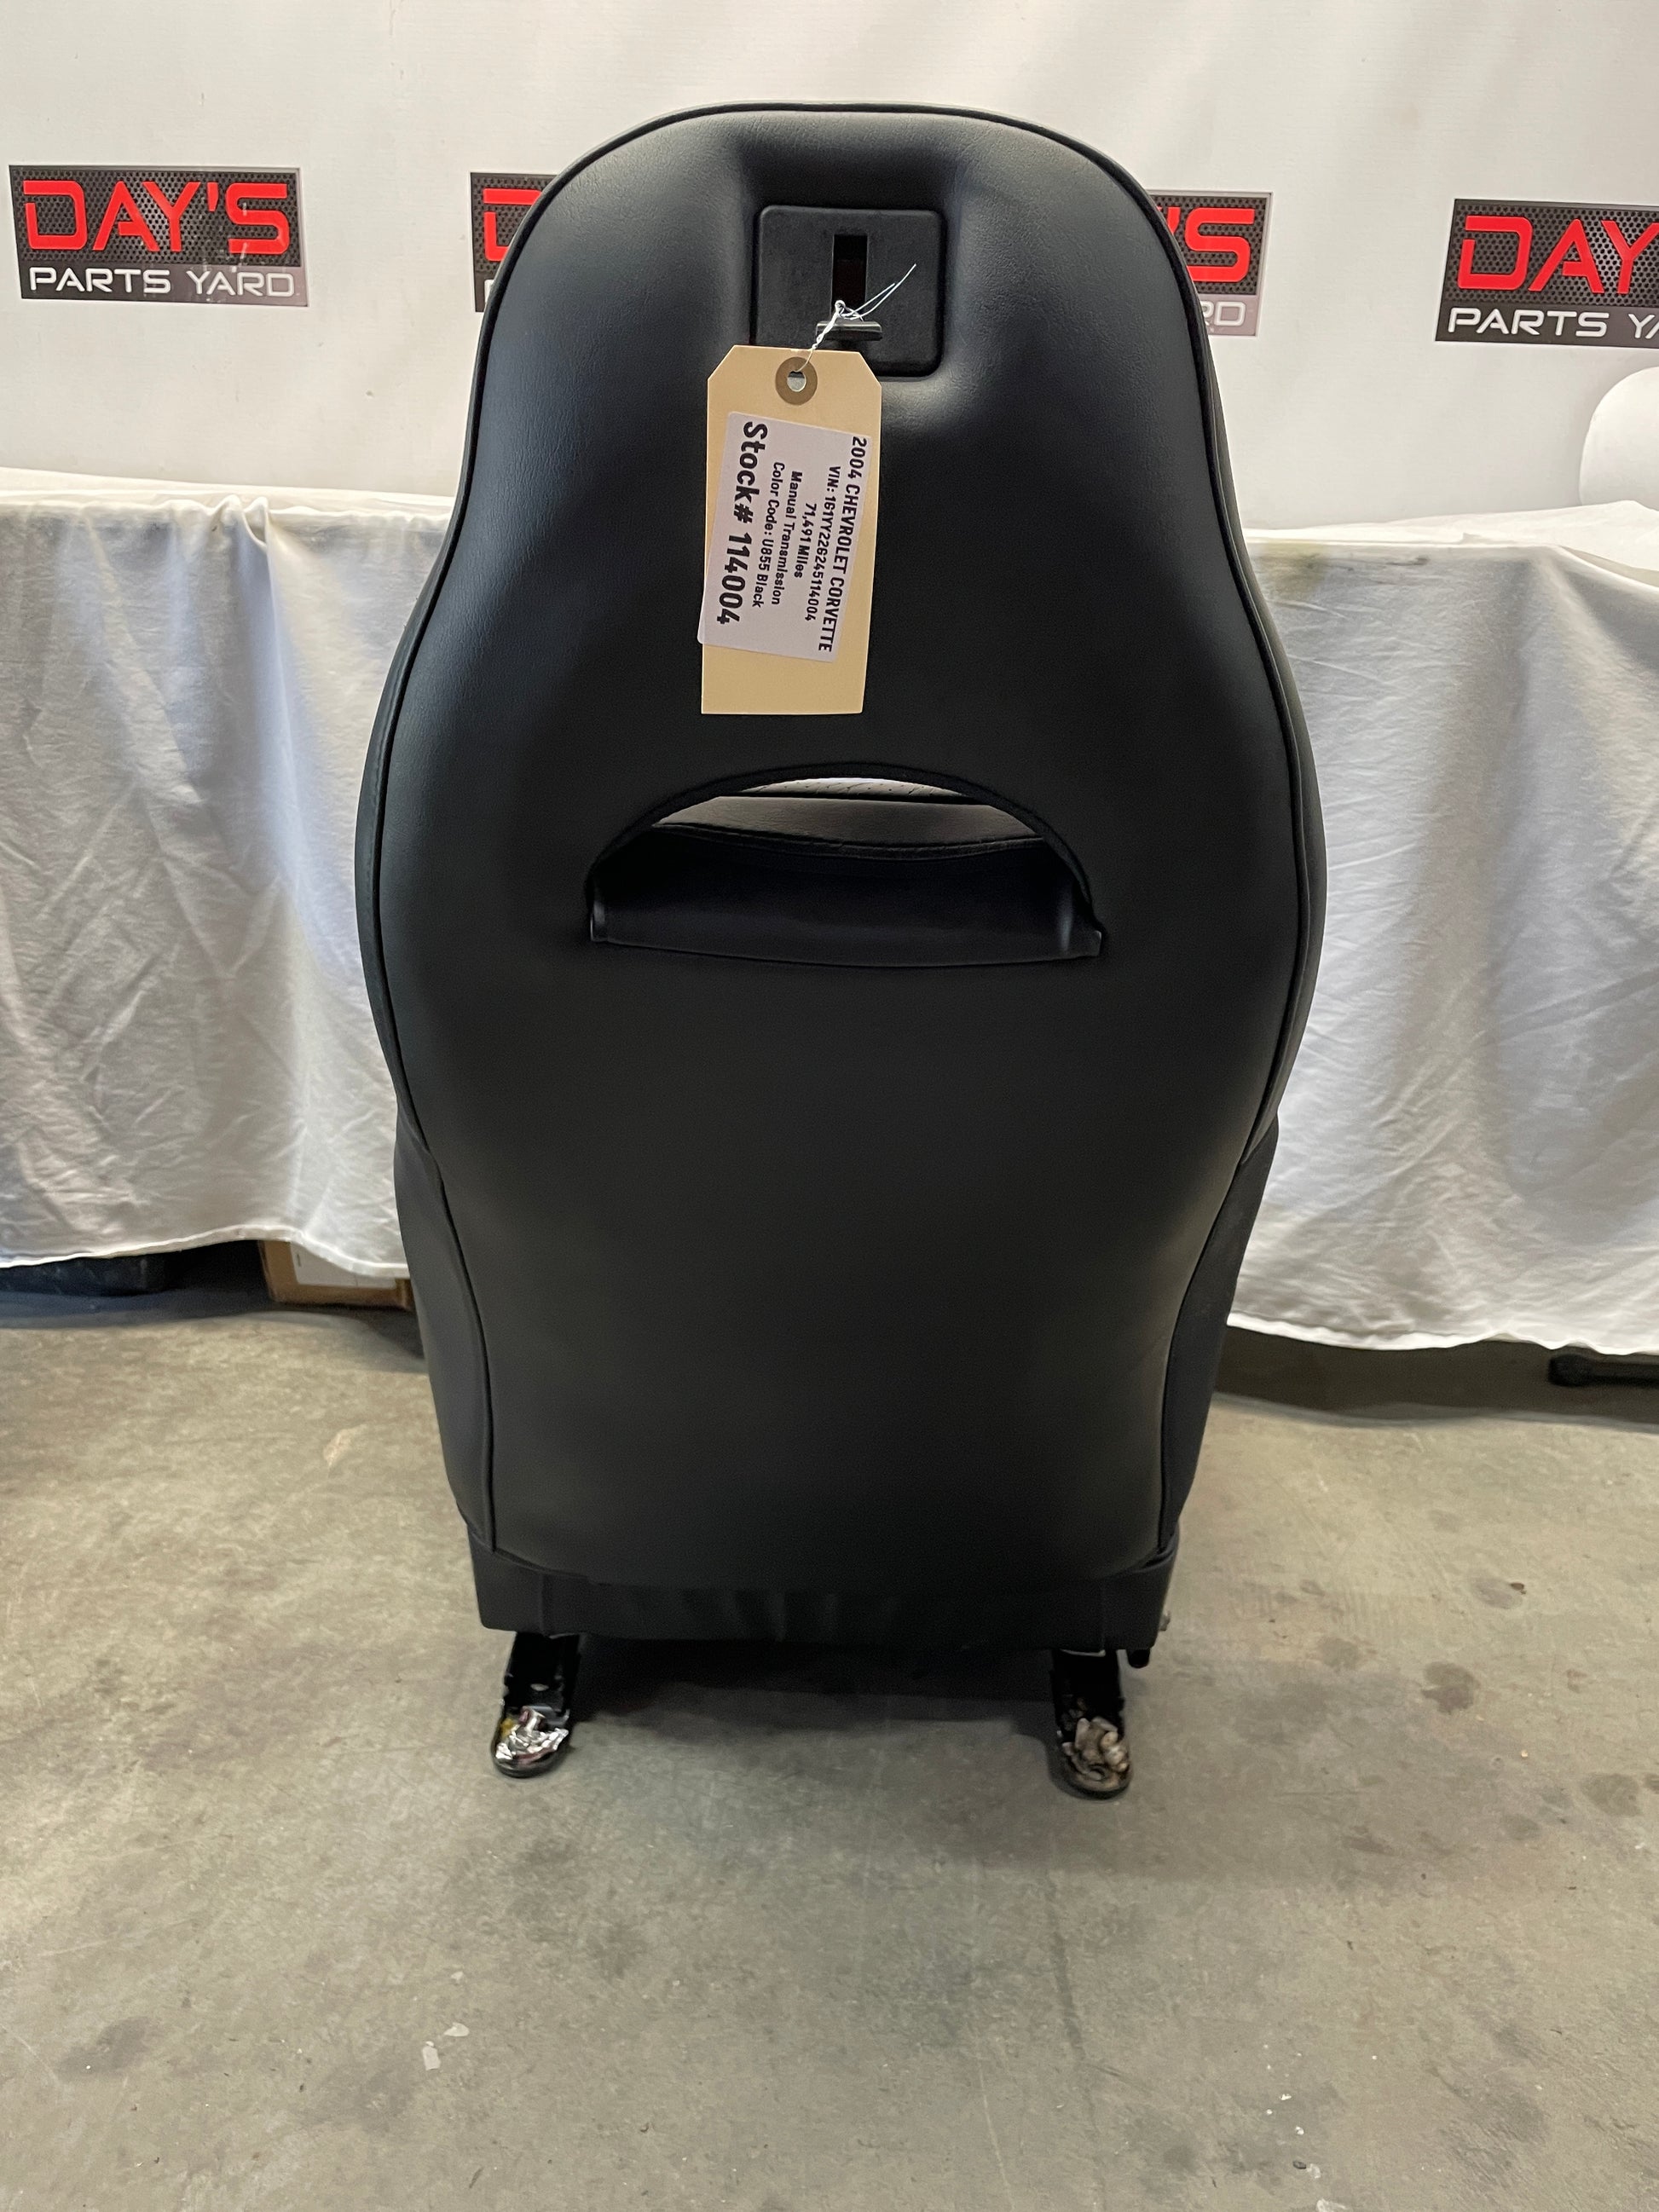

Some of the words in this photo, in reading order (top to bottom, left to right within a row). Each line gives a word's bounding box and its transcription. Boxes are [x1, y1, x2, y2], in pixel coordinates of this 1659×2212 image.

[23, 180, 290, 255] DAY'S
[29, 267, 171, 294] PARTS
[186, 270, 295, 297] YARD
[1448, 307, 1610, 338] PARTS
[733, 421, 769, 524] Stock#
[847, 436, 868, 479] 2004
[769, 462, 785, 496] Color
[788, 471, 803, 520] Manual
[829, 465, 841, 492] VIN:
[764, 499, 780, 535] Code:
[800, 502, 817, 541] 71,491
[833, 483, 861, 575] CHEVROLET
[758, 539, 774, 572] U855
[771, 522, 795, 605] Transmission
[794, 541, 811, 579] Miles
[717, 532, 753, 625] 114004
[752, 573, 769, 608] Black
[818, 575, 846, 652] CORVETTE
